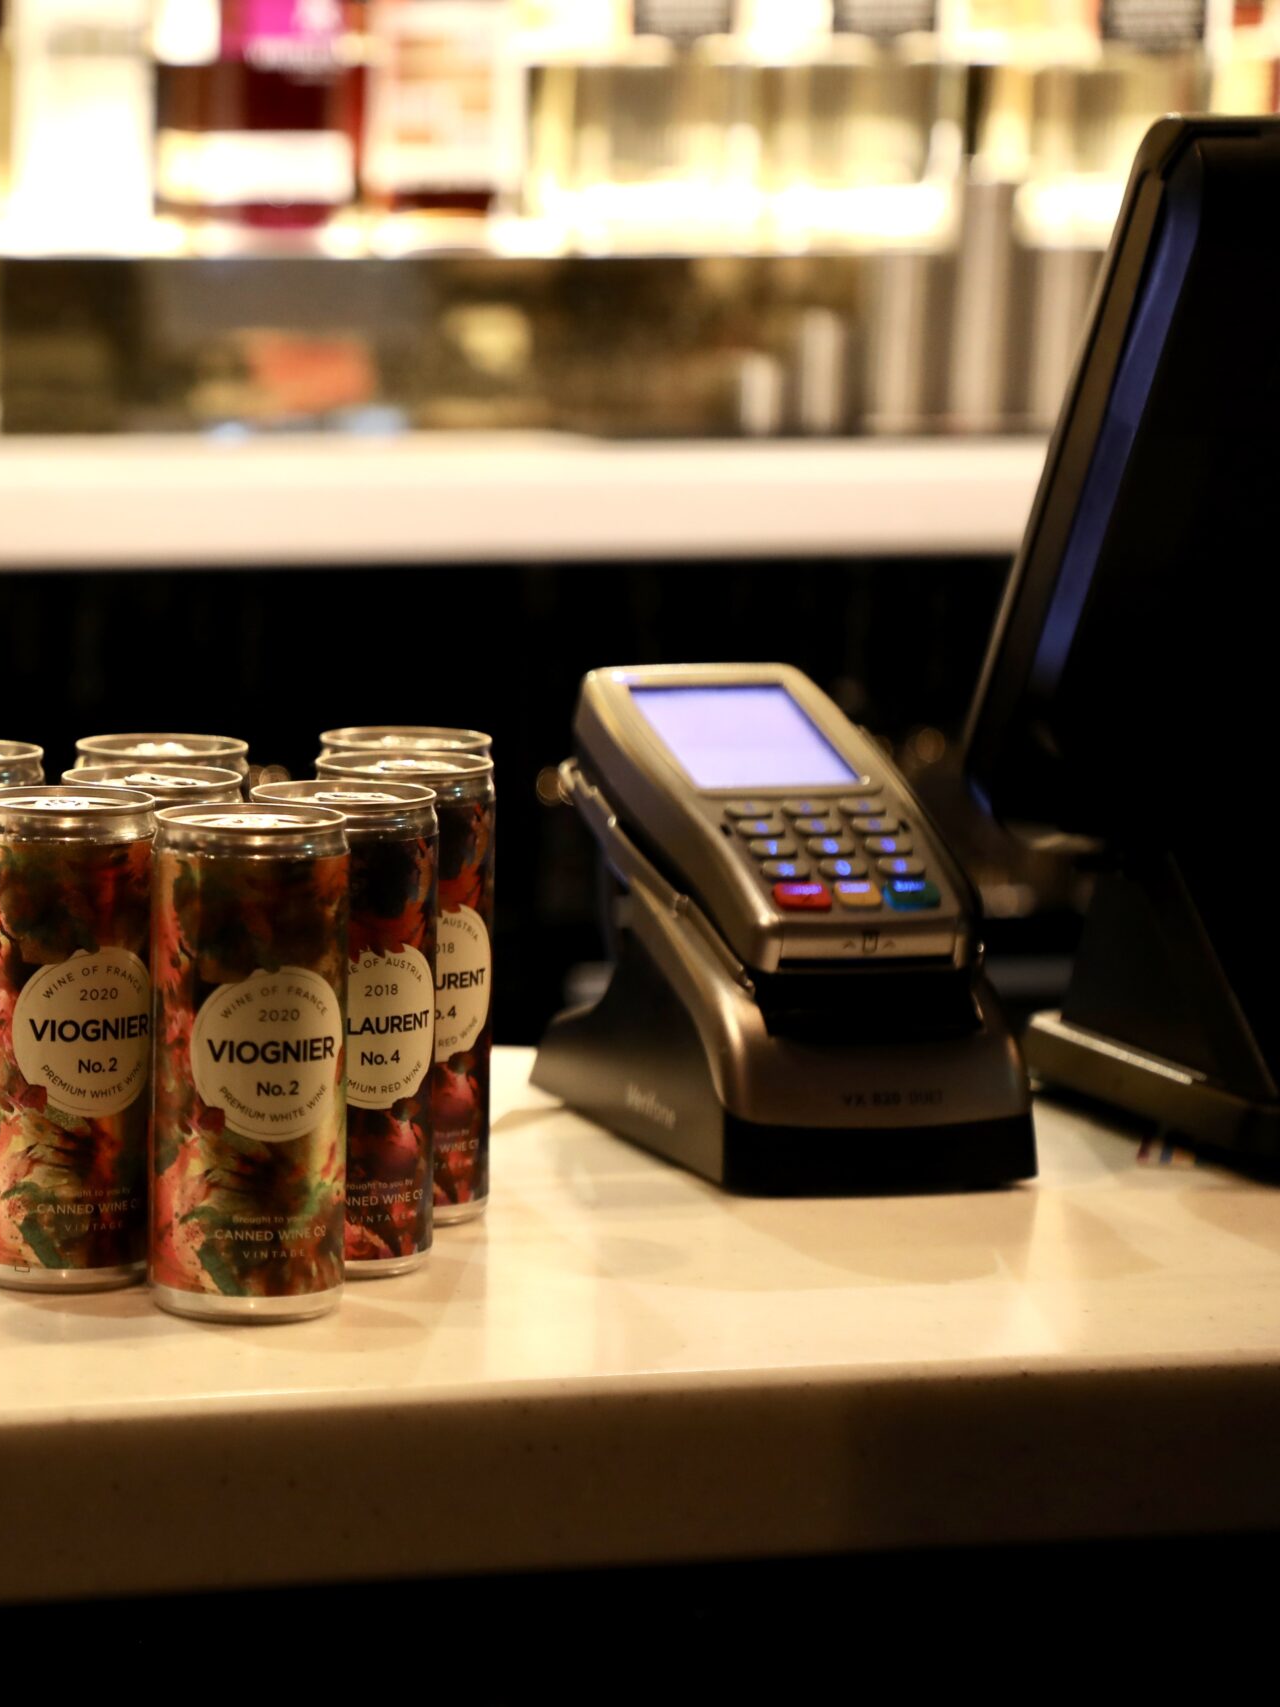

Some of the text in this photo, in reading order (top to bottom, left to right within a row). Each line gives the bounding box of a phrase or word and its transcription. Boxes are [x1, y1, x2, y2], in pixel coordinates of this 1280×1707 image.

[442, 916, 478, 942] AUSTRIA
[42, 965, 143, 999] WINE OF FRANCE
[363, 957, 379, 969] OF
[385, 957, 422, 983] AUSTRIA
[80, 987, 118, 1001] 2020
[221, 985, 328, 1019] WINE OF FRANCE
[364, 984, 399, 997] 2018
[29, 1013, 149, 1043] VIOGNIER
[258, 1009, 300, 1022] 2020
[347, 1010, 430, 1036] LAURENT
[207, 1036, 335, 1065] VIOGNIER
[438, 1036, 458, 1048] RED
[41, 1064, 86, 1097] PREMIUM
[90, 1083, 123, 1099] WHITE
[381, 1081, 401, 1094] RED
[403, 1060, 422, 1085] WINE
[220, 1084, 327, 1123] PREMIUM WHITE WINE
[438, 1141, 467, 1153] WINE
[36, 1200, 128, 1215] CANNED WINE
[382, 1191, 411, 1204] WINE
[214, 1229, 274, 1241] CANNED
[278, 1227, 311, 1241] WINE
